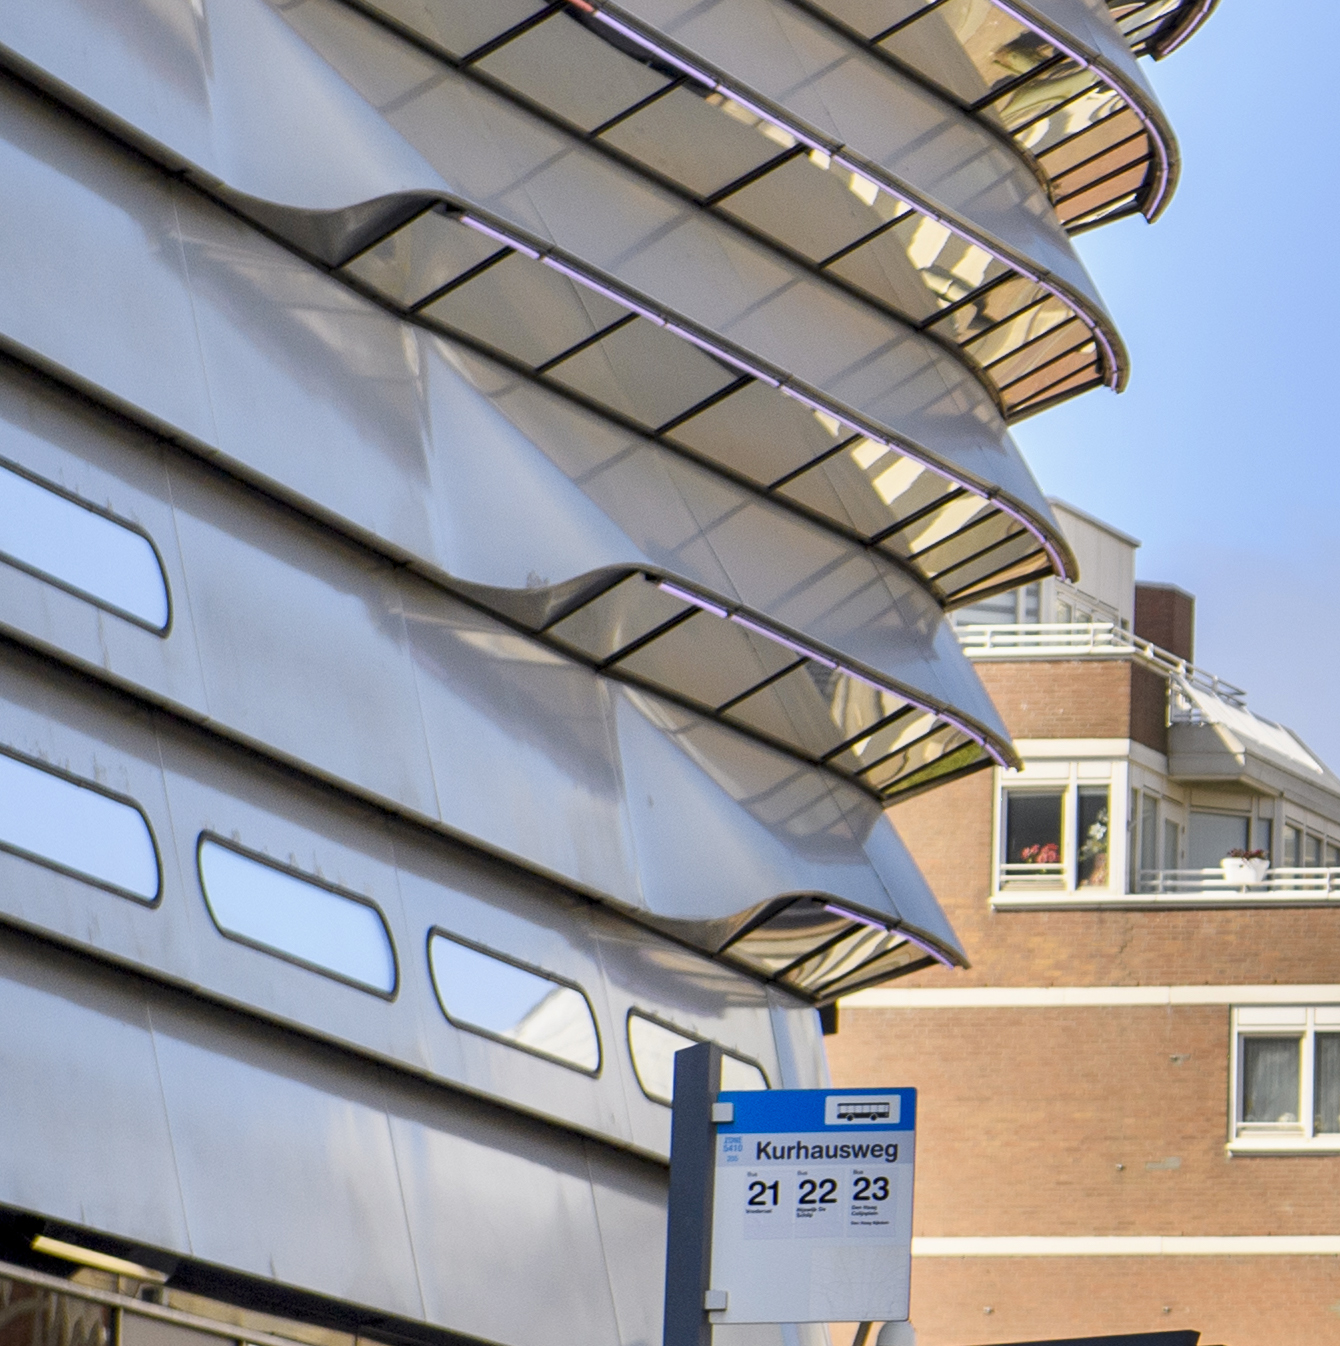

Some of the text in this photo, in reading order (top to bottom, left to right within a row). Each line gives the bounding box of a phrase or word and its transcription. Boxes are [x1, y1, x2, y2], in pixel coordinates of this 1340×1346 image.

[756, 1140, 898, 1163] Kurhausweg
[748, 1180, 779, 1206] 21
[798, 1178, 838, 1204] 22
[853, 1176, 890, 1201] 23
